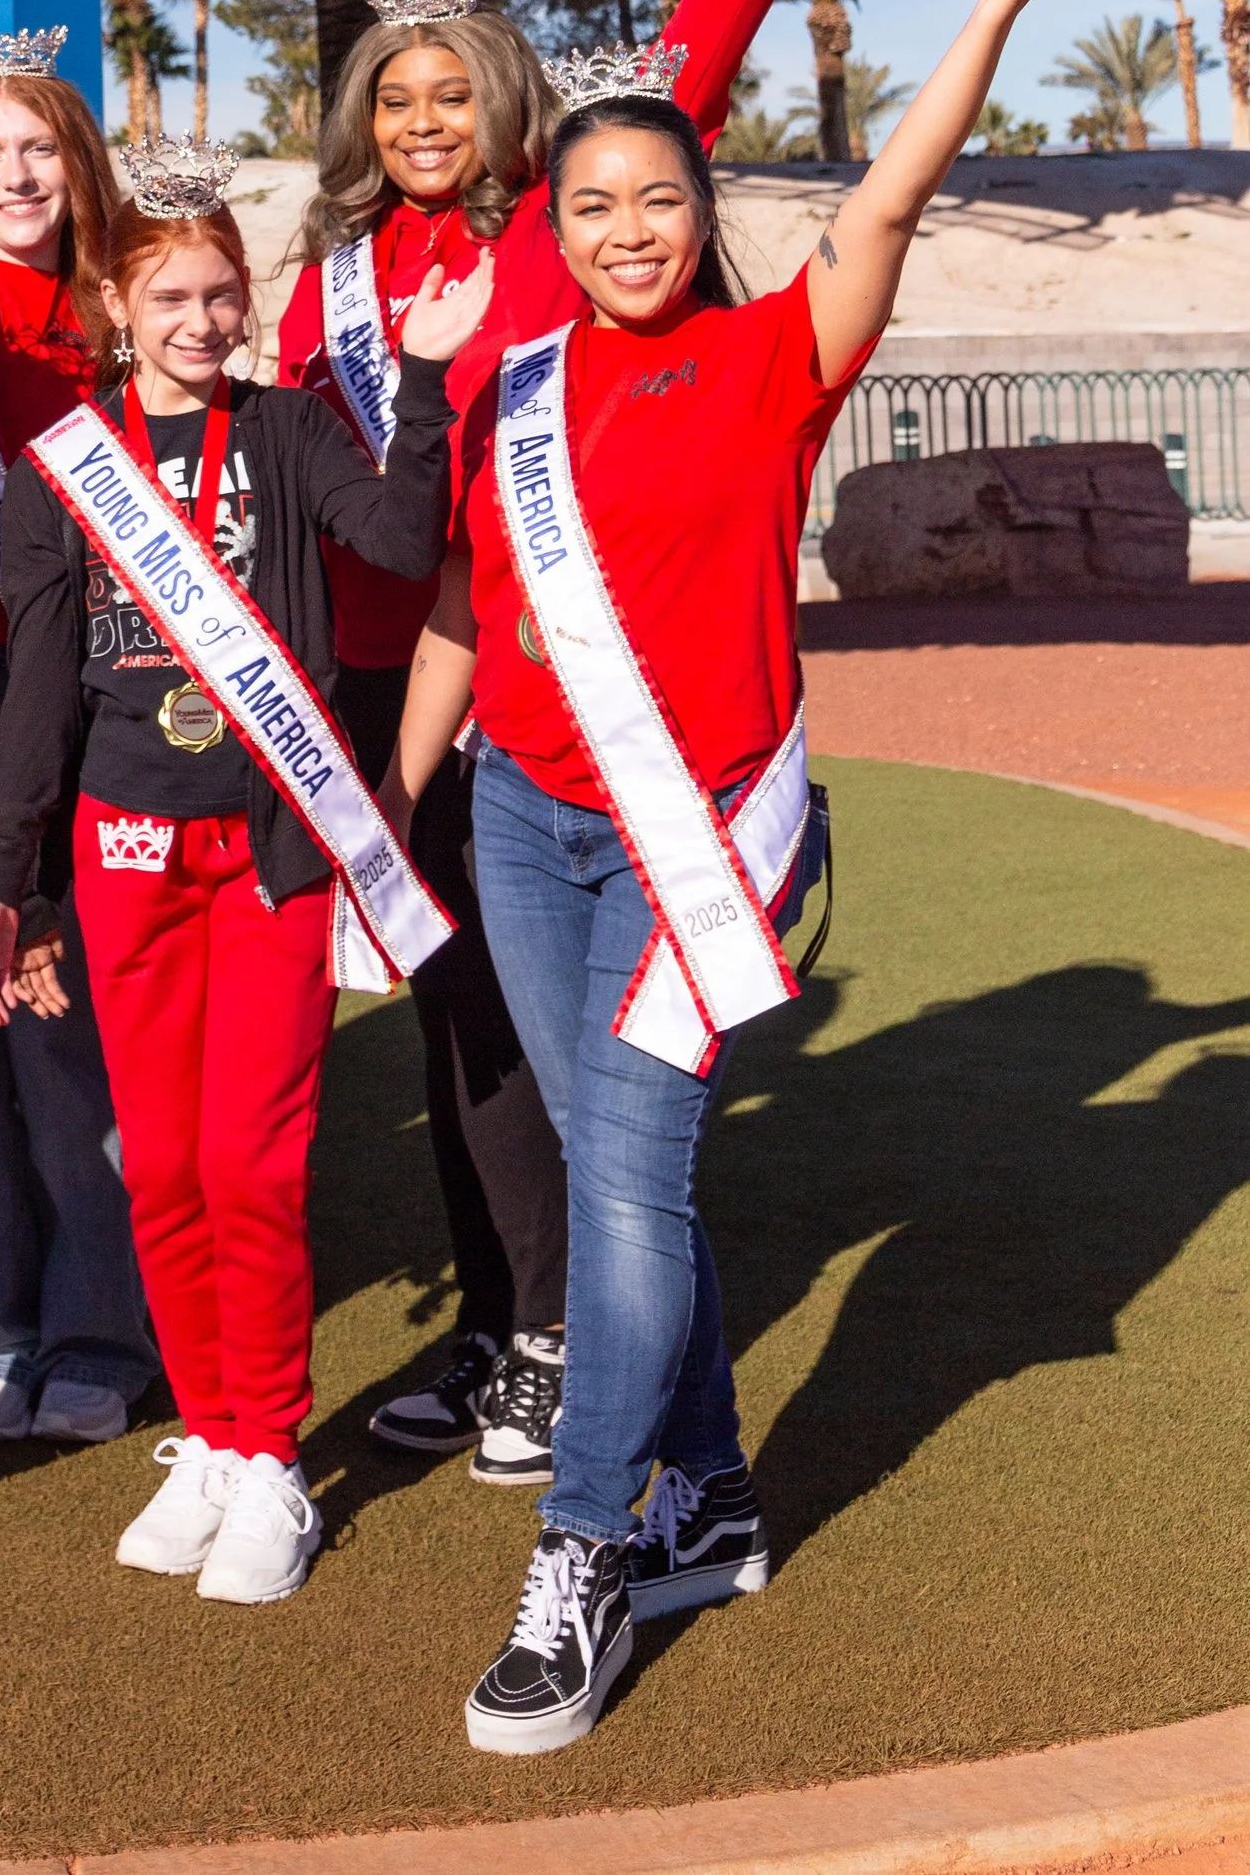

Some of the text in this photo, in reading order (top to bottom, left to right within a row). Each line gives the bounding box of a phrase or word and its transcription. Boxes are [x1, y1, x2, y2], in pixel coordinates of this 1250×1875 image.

[334, 293, 368, 316] of
[338, 320, 397, 442] AMERICA
[510, 399, 551, 420] of
[509, 432, 569, 575] AMERICA
[69, 442, 149, 541] YOUNG
[132, 530, 204, 615] MISS
[196, 617, 246, 647] of
[225, 655, 334, 799] AMERICA
[359, 846, 394, 891] 2025
[684, 896, 739, 939] 2025
